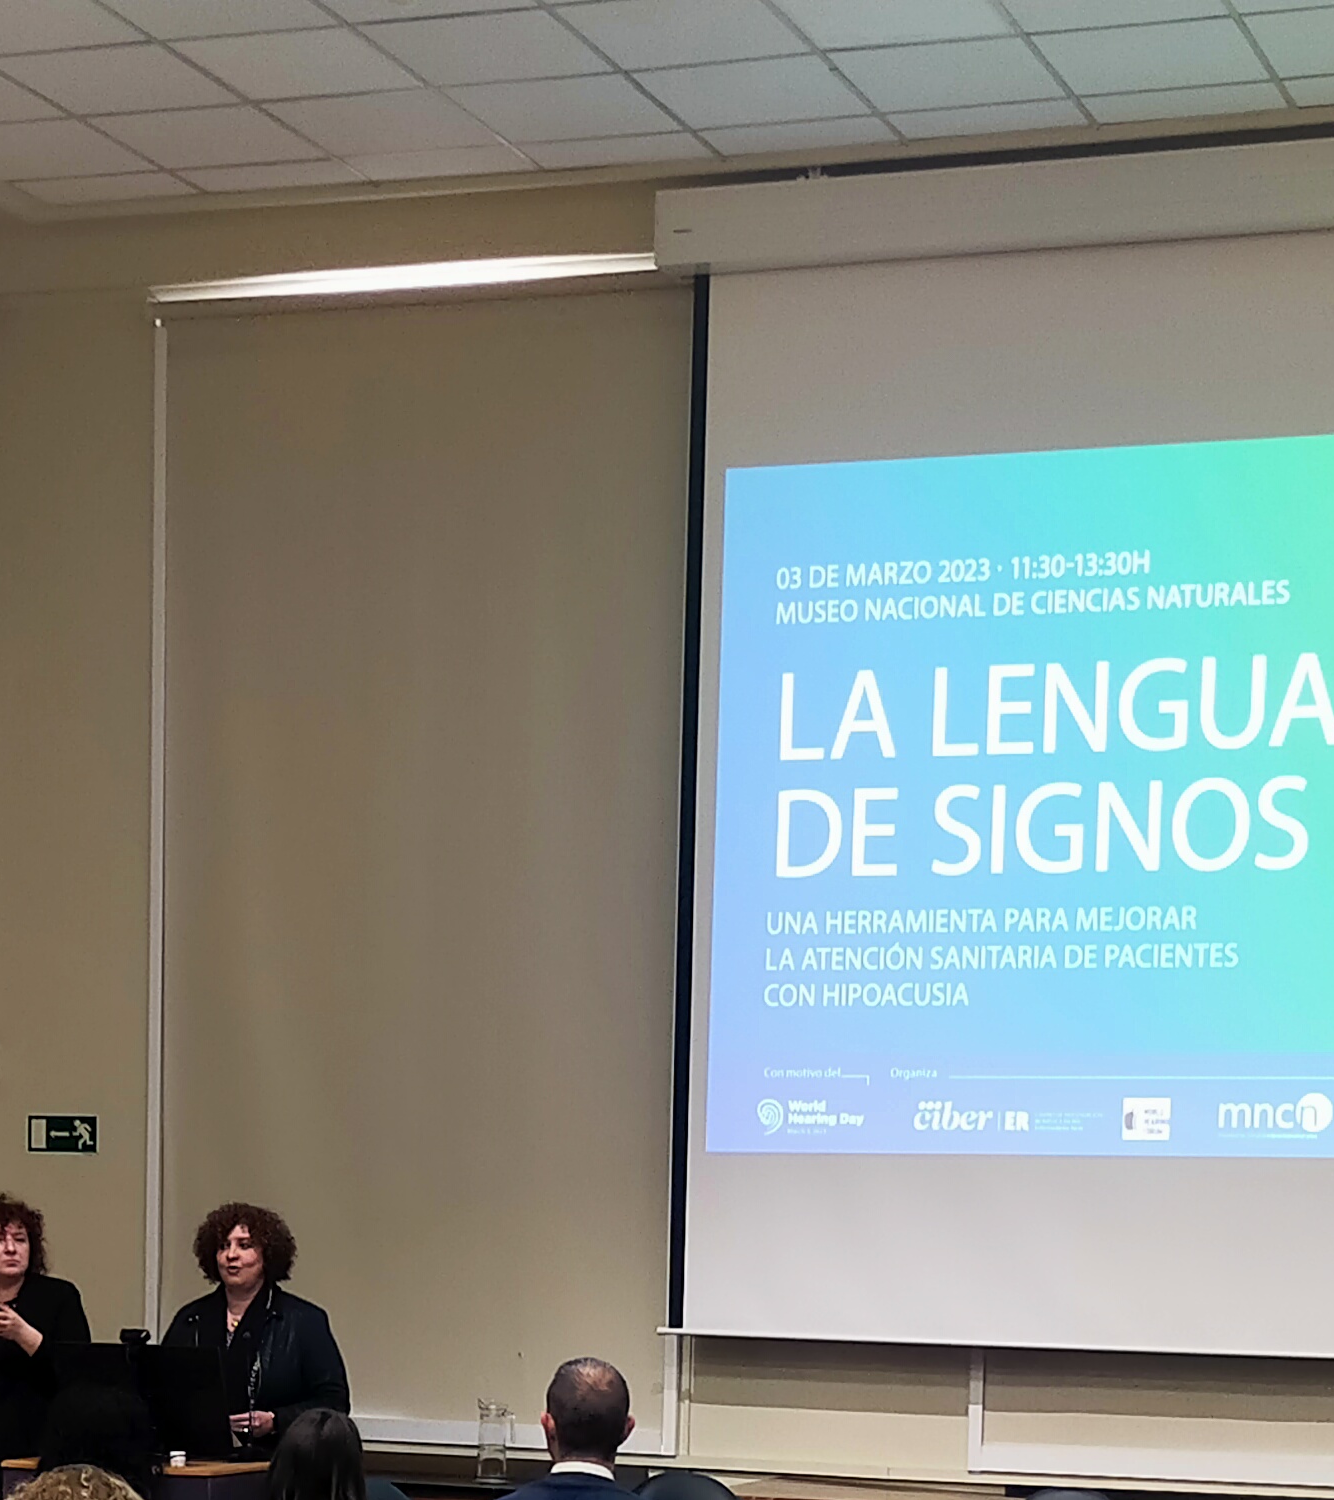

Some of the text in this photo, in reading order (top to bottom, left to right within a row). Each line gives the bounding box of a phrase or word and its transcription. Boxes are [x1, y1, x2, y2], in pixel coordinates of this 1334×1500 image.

[776, 549, 1150, 590] 03 DE MARZO 2023 11:30-13:30H
[775, 579, 1291, 625] MUSEO NACIONAL DE CIENCIAS NATURALES
[779, 668, 896, 761] LA
[775, 774, 1310, 878] DE SIGNOS
[767, 905, 1197, 935] UNA HERRAMIENTA PARA MEJORAR
[765, 942, 1239, 971] LA ATENCIÓN SANITARIA DE PACIENTES
[764, 982, 969, 1007] CON HIPOACUSIA
[764, 1067, 841, 1078] Con motivo del
[890, 1067, 938, 1080] Organiza
[788, 1100, 826, 1113] World
[788, 1112, 864, 1127] Hearing Day
[913, 1101, 993, 1131] ciber
[1004, 1111, 1029, 1132] ER
